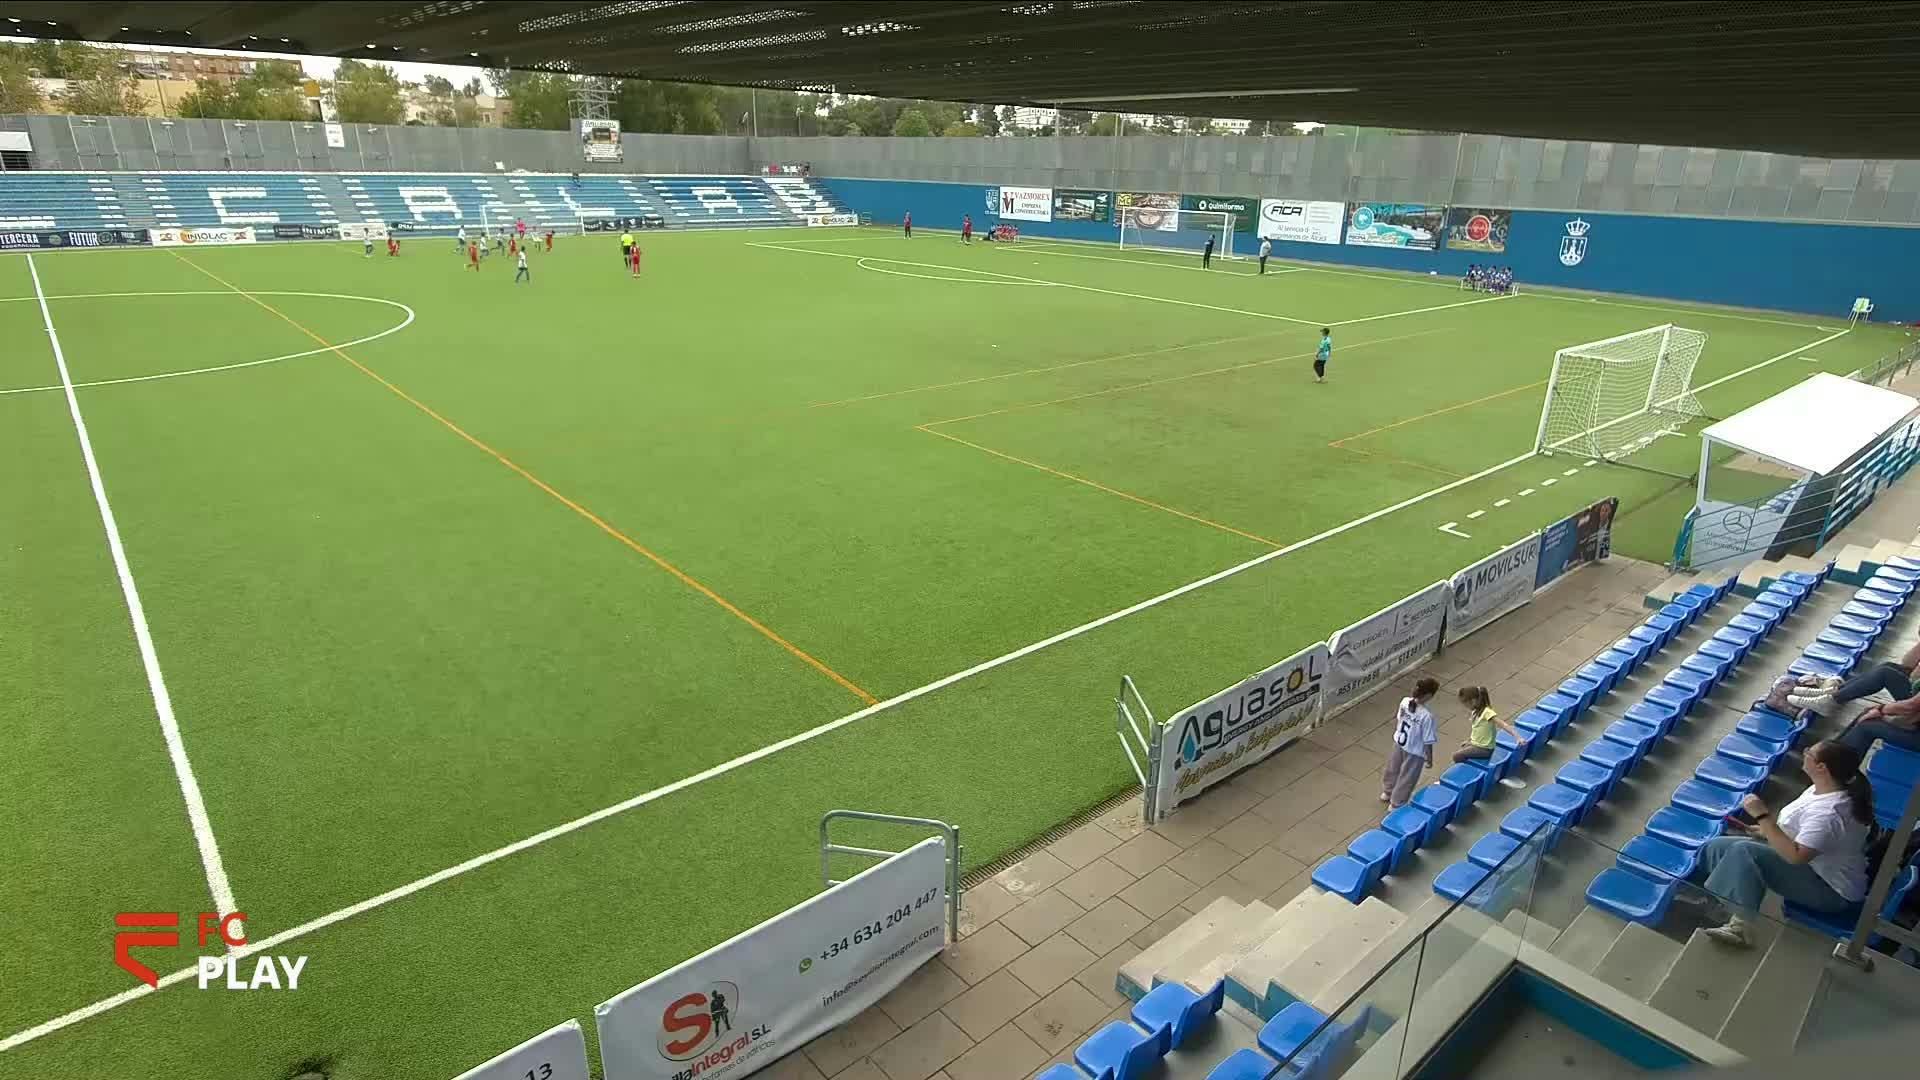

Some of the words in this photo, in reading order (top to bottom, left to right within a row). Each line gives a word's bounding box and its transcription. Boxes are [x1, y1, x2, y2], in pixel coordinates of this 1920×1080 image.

[0, 233, 40, 245] TERCERA
[1475, 544, 1537, 591] MOVILSUR
[1398, 720, 1411, 746] 5
[820, 937, 849, 961] +34
[854, 921, 883, 945] 634
[886, 904, 911, 929] 204
[914, 888, 937, 910] 447
